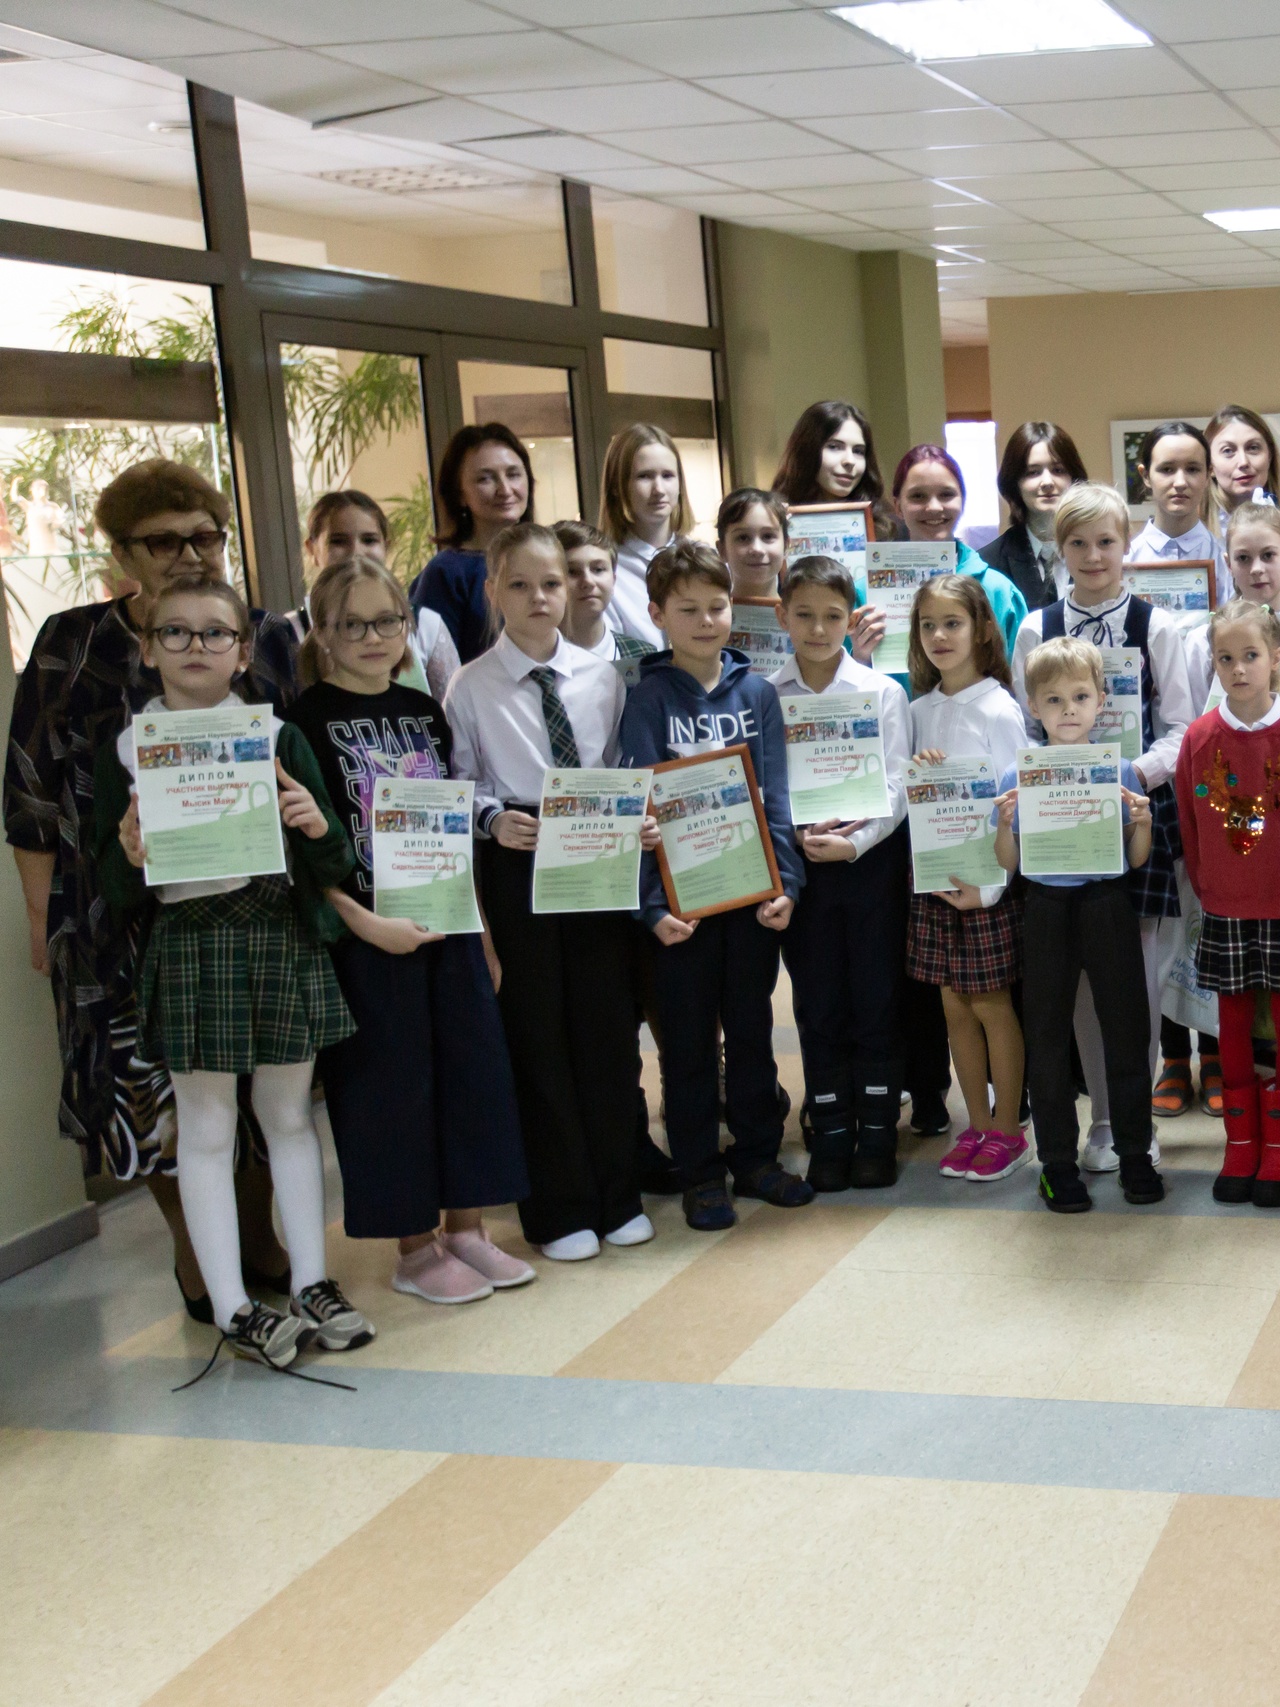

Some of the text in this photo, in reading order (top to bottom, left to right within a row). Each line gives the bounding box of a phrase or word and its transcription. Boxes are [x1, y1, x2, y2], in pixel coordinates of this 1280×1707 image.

[670, 709, 759, 744] INSIDE
[327, 715, 448, 776] SPACE
[814, 745, 854, 755] ДИПЛОМ
[178, 771, 235, 784] ДИПЛОМ
[1049, 790, 1090, 798] ДИПЛОМ
[936, 806, 974, 815] ДИПЛОМ
[571, 823, 614, 831] ДИПЛОМ
[687, 815, 727, 831] ДИПЛОМ
[404, 840, 443, 848] ДИПЛОМ
